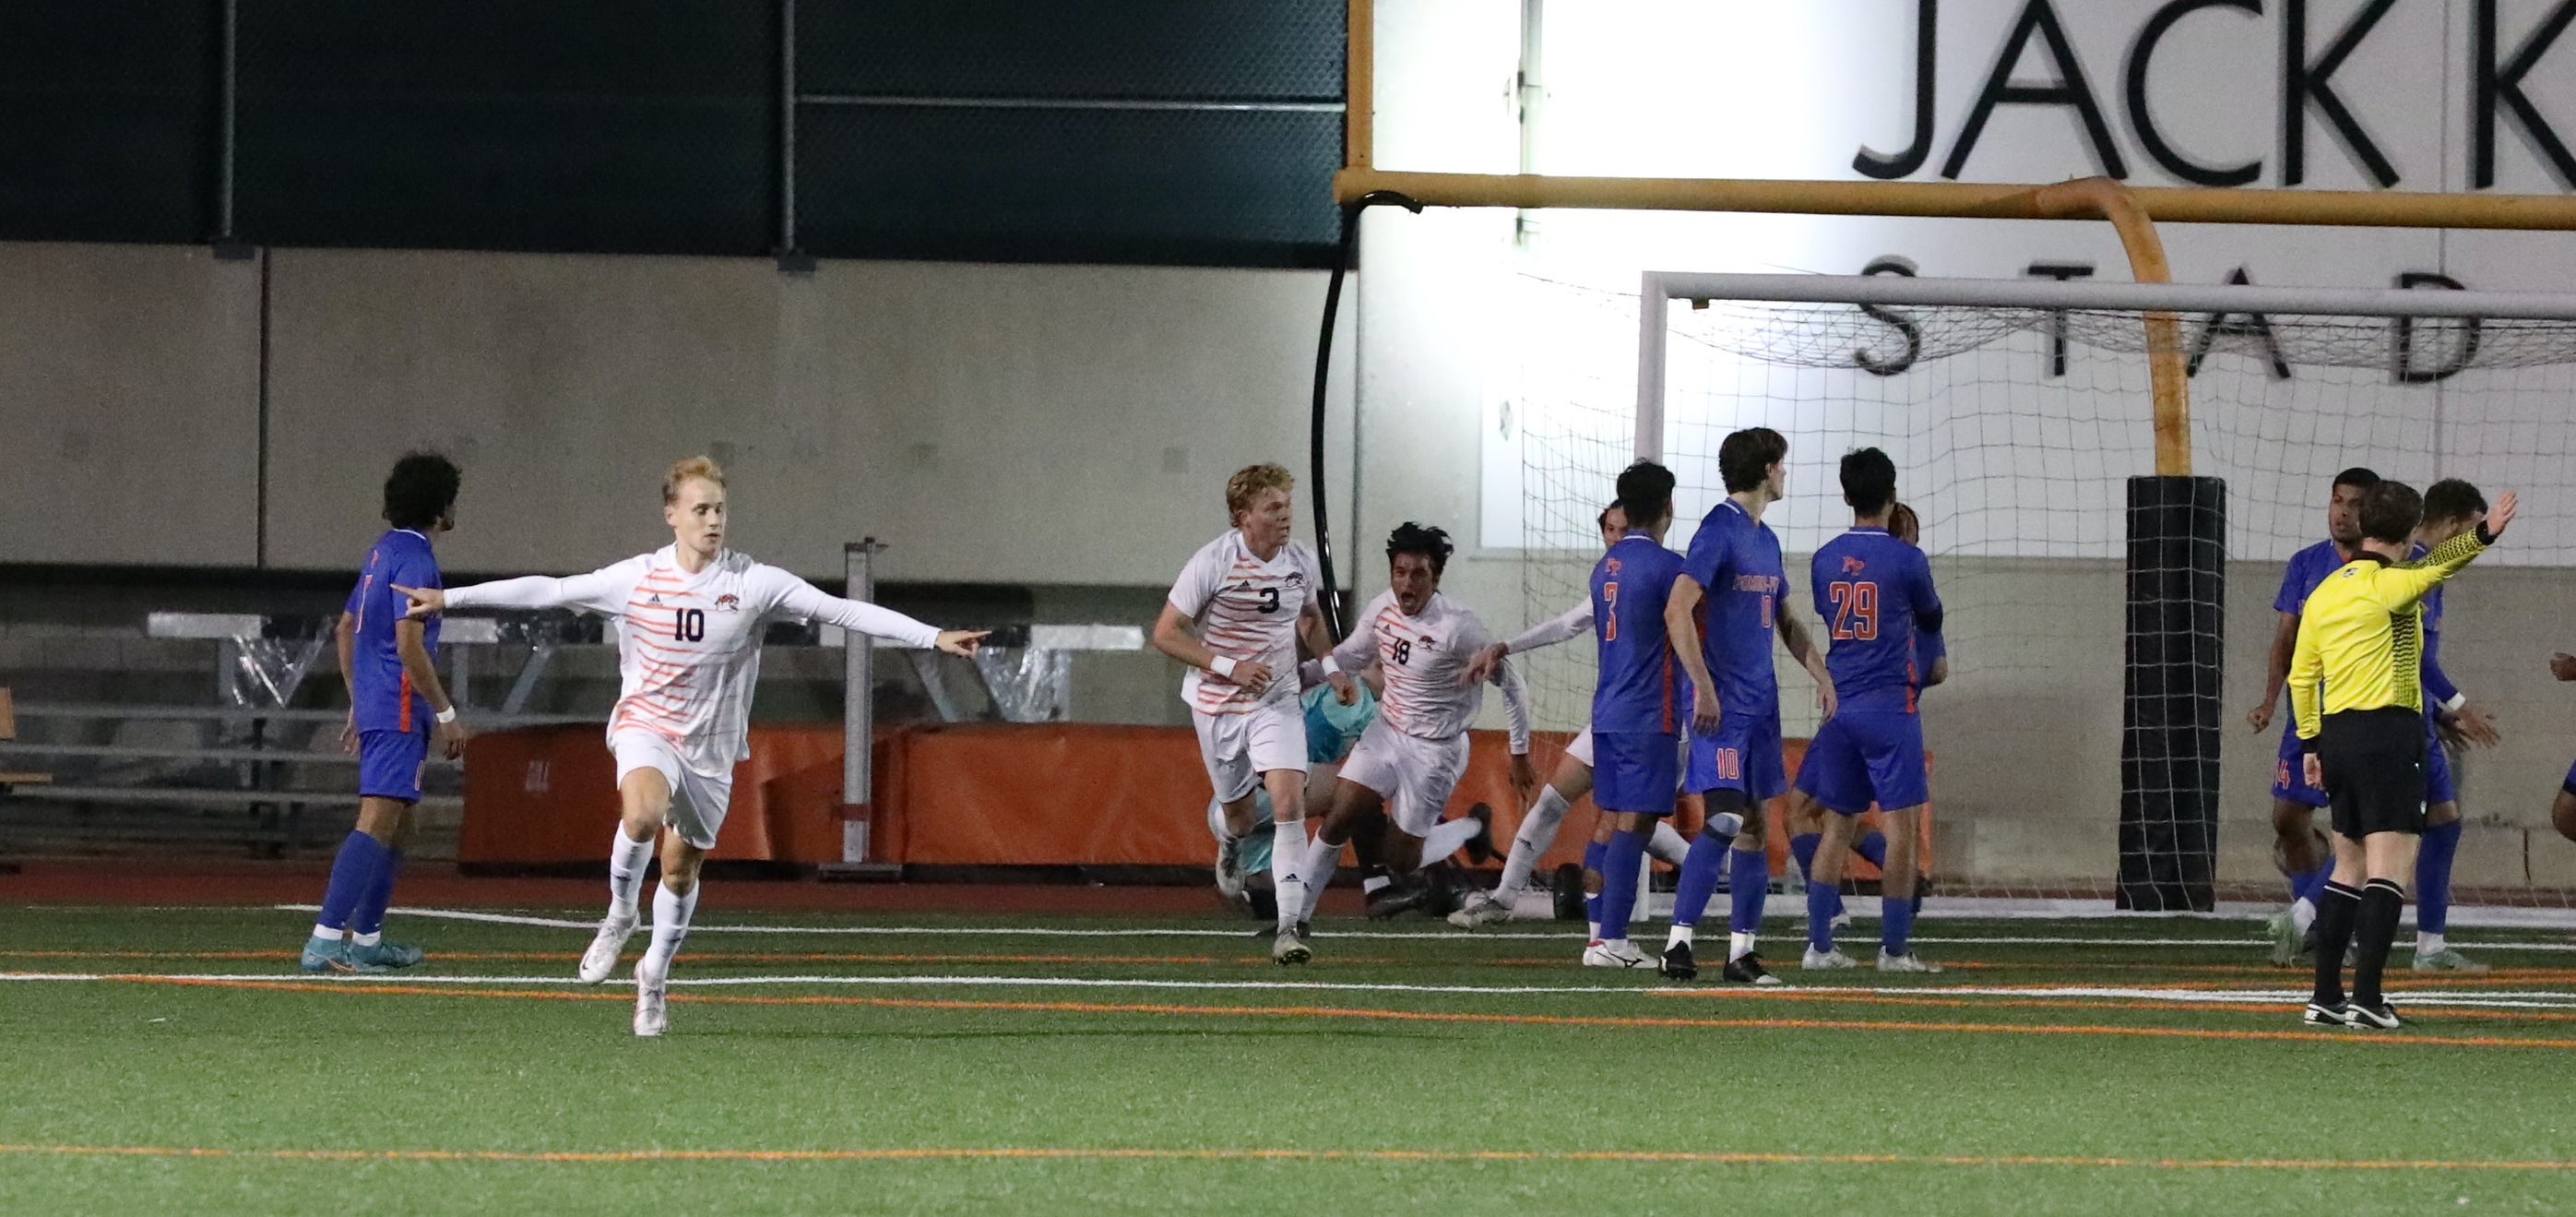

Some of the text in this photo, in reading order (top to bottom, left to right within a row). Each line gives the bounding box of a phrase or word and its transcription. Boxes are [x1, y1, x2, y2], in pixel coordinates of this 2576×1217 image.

[1852, 0, 2401, 188] JACK
[1853, 261, 2481, 384] STAD
[1258, 586, 1280, 614] 3
[1603, 581, 1619, 641] 3
[1829, 580, 1878, 641] 29
[674, 607, 705, 642] 10
[1391, 637, 1411, 665] 18
[1716, 747, 1739, 781] 10
